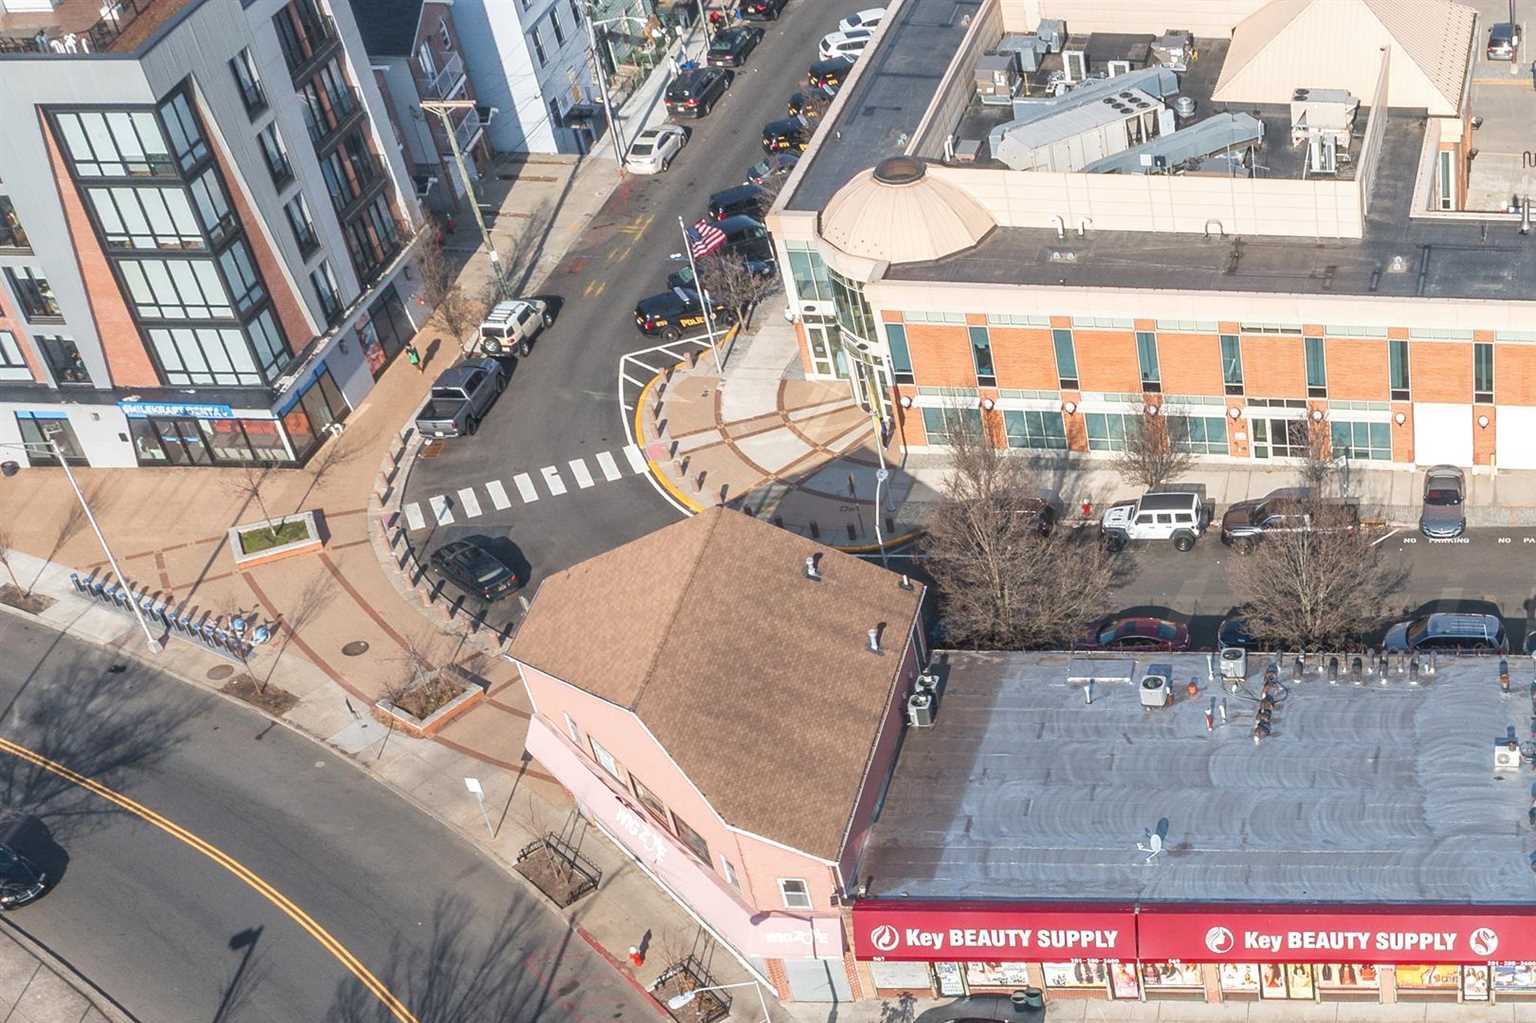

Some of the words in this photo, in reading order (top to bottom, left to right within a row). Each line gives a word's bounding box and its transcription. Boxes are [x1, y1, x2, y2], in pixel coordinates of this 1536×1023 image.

[906, 929, 944, 949] Key
[950, 929, 1031, 947] BEAUTY
[1038, 929, 1118, 948] SUPPLY
[1245, 932, 1282, 952] Key
[1288, 932, 1370, 950] BEAUTY
[1376, 932, 1457, 951] SUPPLY
